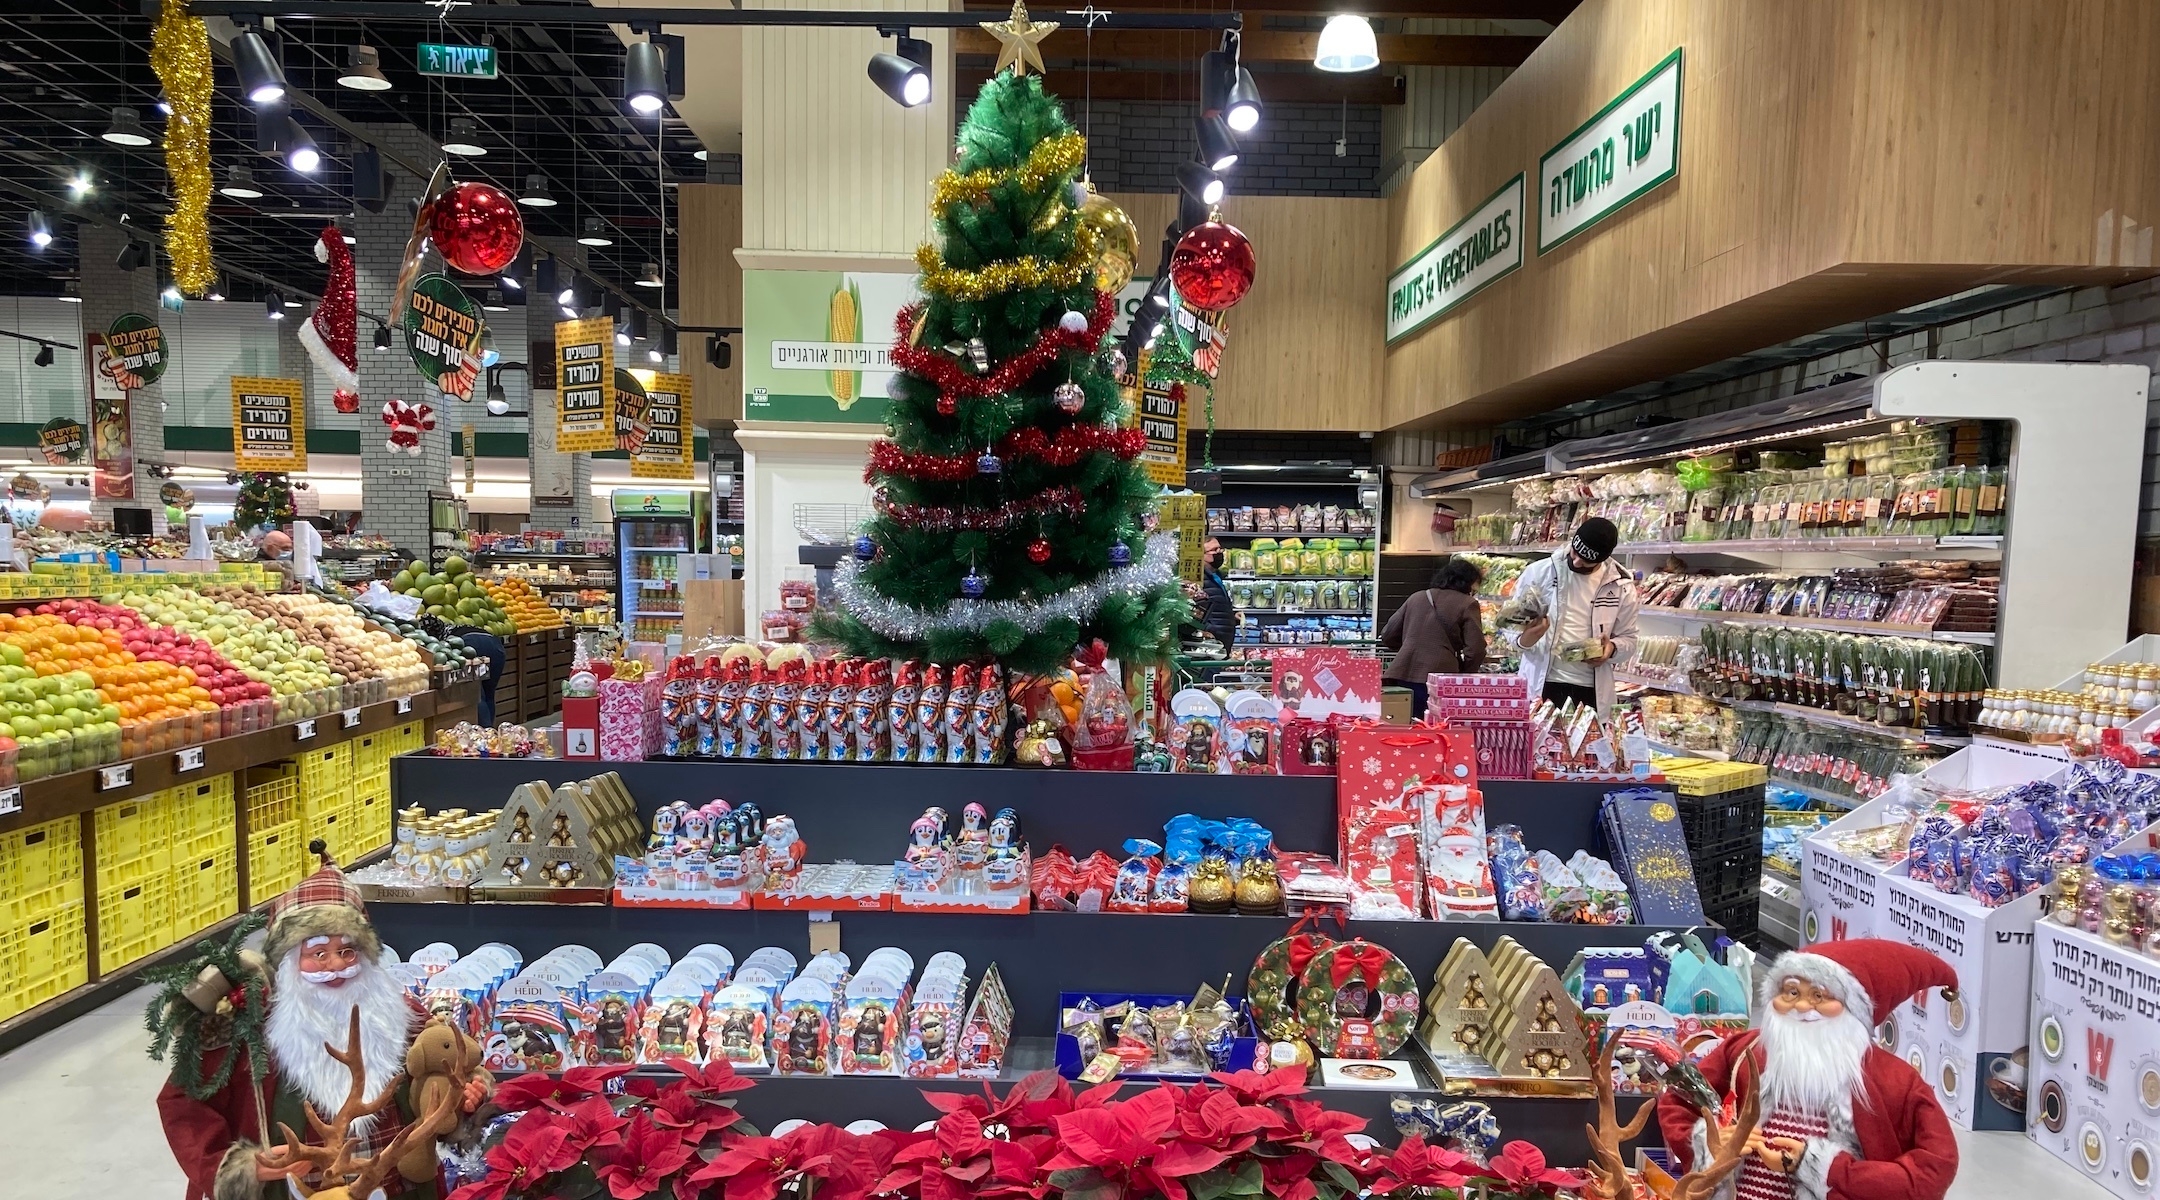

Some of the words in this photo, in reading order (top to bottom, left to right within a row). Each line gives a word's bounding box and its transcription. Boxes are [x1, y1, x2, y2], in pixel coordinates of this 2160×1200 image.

[445, 46, 489, 75] יציאה
[1622, 102, 1662, 167] ישר
[1550, 136, 1615, 218] מהשדה
[1392, 272, 1424, 322] FRUITS
[1426, 267, 1435, 300] &
[1436, 209, 1512, 292] VEGETABLES
[413, 292, 433, 315] לכם
[422, 315, 449, 340] לחגוג
[435, 303, 475, 334] מזכירים
[1178, 306, 1196, 333] שנה
[111, 331, 128, 347] לכם
[129, 326, 160, 343] מזכירים
[451, 328, 468, 349] איך
[1197, 319, 1212, 343] סוף
[123, 341, 145, 355] לחגוג
[145, 339, 160, 351] איך
[415, 331, 440, 357] שנה
[565, 344, 599, 361] ממשיכים
[124, 354, 143, 370] שנה
[144, 351, 161, 367] סוף
[442, 343, 462, 367] סוף
[778, 347, 828, 363] אורגניים
[834, 349, 872, 364] ופירות
[566, 362, 600, 384] להוריד
[244, 395, 286, 406] ממשיכים
[566, 389, 600, 408] מחירים
[615, 391, 645, 408] מזכירי
[245, 408, 287, 423] להוריד
[650, 407, 677, 424] להורי
[246, 427, 288, 440] מחירים
[646, 430, 678, 443] מחירי
[1144, 421, 1175, 440] מחירים
[1573, 534, 1600, 560] GUESS
[1311, 653, 1343, 672] Hamlet
[1145, 673, 1154, 711] אורגניים
[1812, 850, 1828, 867] תרוץ
[1829, 857, 1839, 872] רק
[1812, 868, 1832, 888] לבחור
[1839, 860, 1852, 878] הוא
[1853, 865, 1876, 888] החורף
[377, 889, 415, 898] FERRERO
[1832, 877, 1842, 892] רק
[1843, 881, 1858, 900] נותר
[1859, 887, 1875, 908] לכם
[1889, 887, 1907, 907] תרוץ
[1908, 897, 1919, 914] רק
[1889, 907, 1911, 930] לבחור
[1921, 902, 1937, 922] הוא
[1913, 920, 1923, 937] רק
[1938, 910, 1965, 935] החורף
[1925, 926, 1944, 947] נותר
[1946, 935, 1964, 957] לכם
[1996, 930, 2034, 945] חדש
[2052, 938, 2079, 962] תרוץ
[2083, 950, 2098, 970] רק
[2052, 961, 2085, 989] לבחור
[2101, 957, 2122, 980] הוא
[515, 987, 542, 996] HEIDI
[2089, 977, 2104, 997] רק
[2108, 985, 2133, 1010] נותר
[1627, 1012, 1656, 1021] HEIDI
[2087, 1027, 2114, 1081] W
[1499, 1083, 1542, 1092] FERRERO
